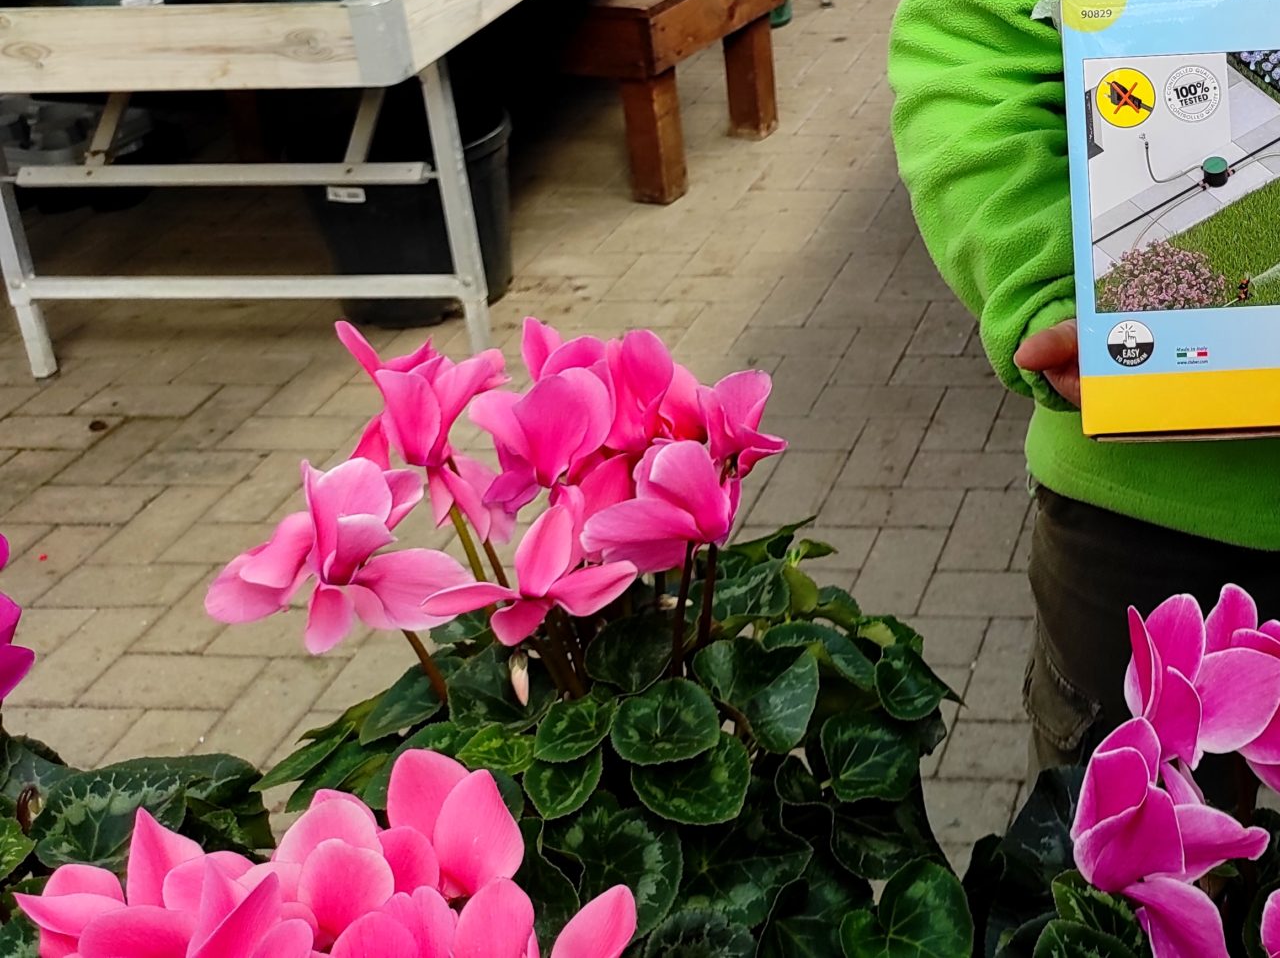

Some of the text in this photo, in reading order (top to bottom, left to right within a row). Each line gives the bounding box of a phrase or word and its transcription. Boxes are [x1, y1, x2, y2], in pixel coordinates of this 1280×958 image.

[1081, 8, 1112, 19] 90829
[1167, 67, 1217, 96] CONTROLLED QUALITY
[1173, 81, 1210, 100] 100%
[1179, 93, 1209, 107] TESTED
[1170, 103, 1204, 121] CONTROLLED
[1115, 352, 1149, 365] TO PROGRAM
[1122, 348, 1140, 358] EASY
